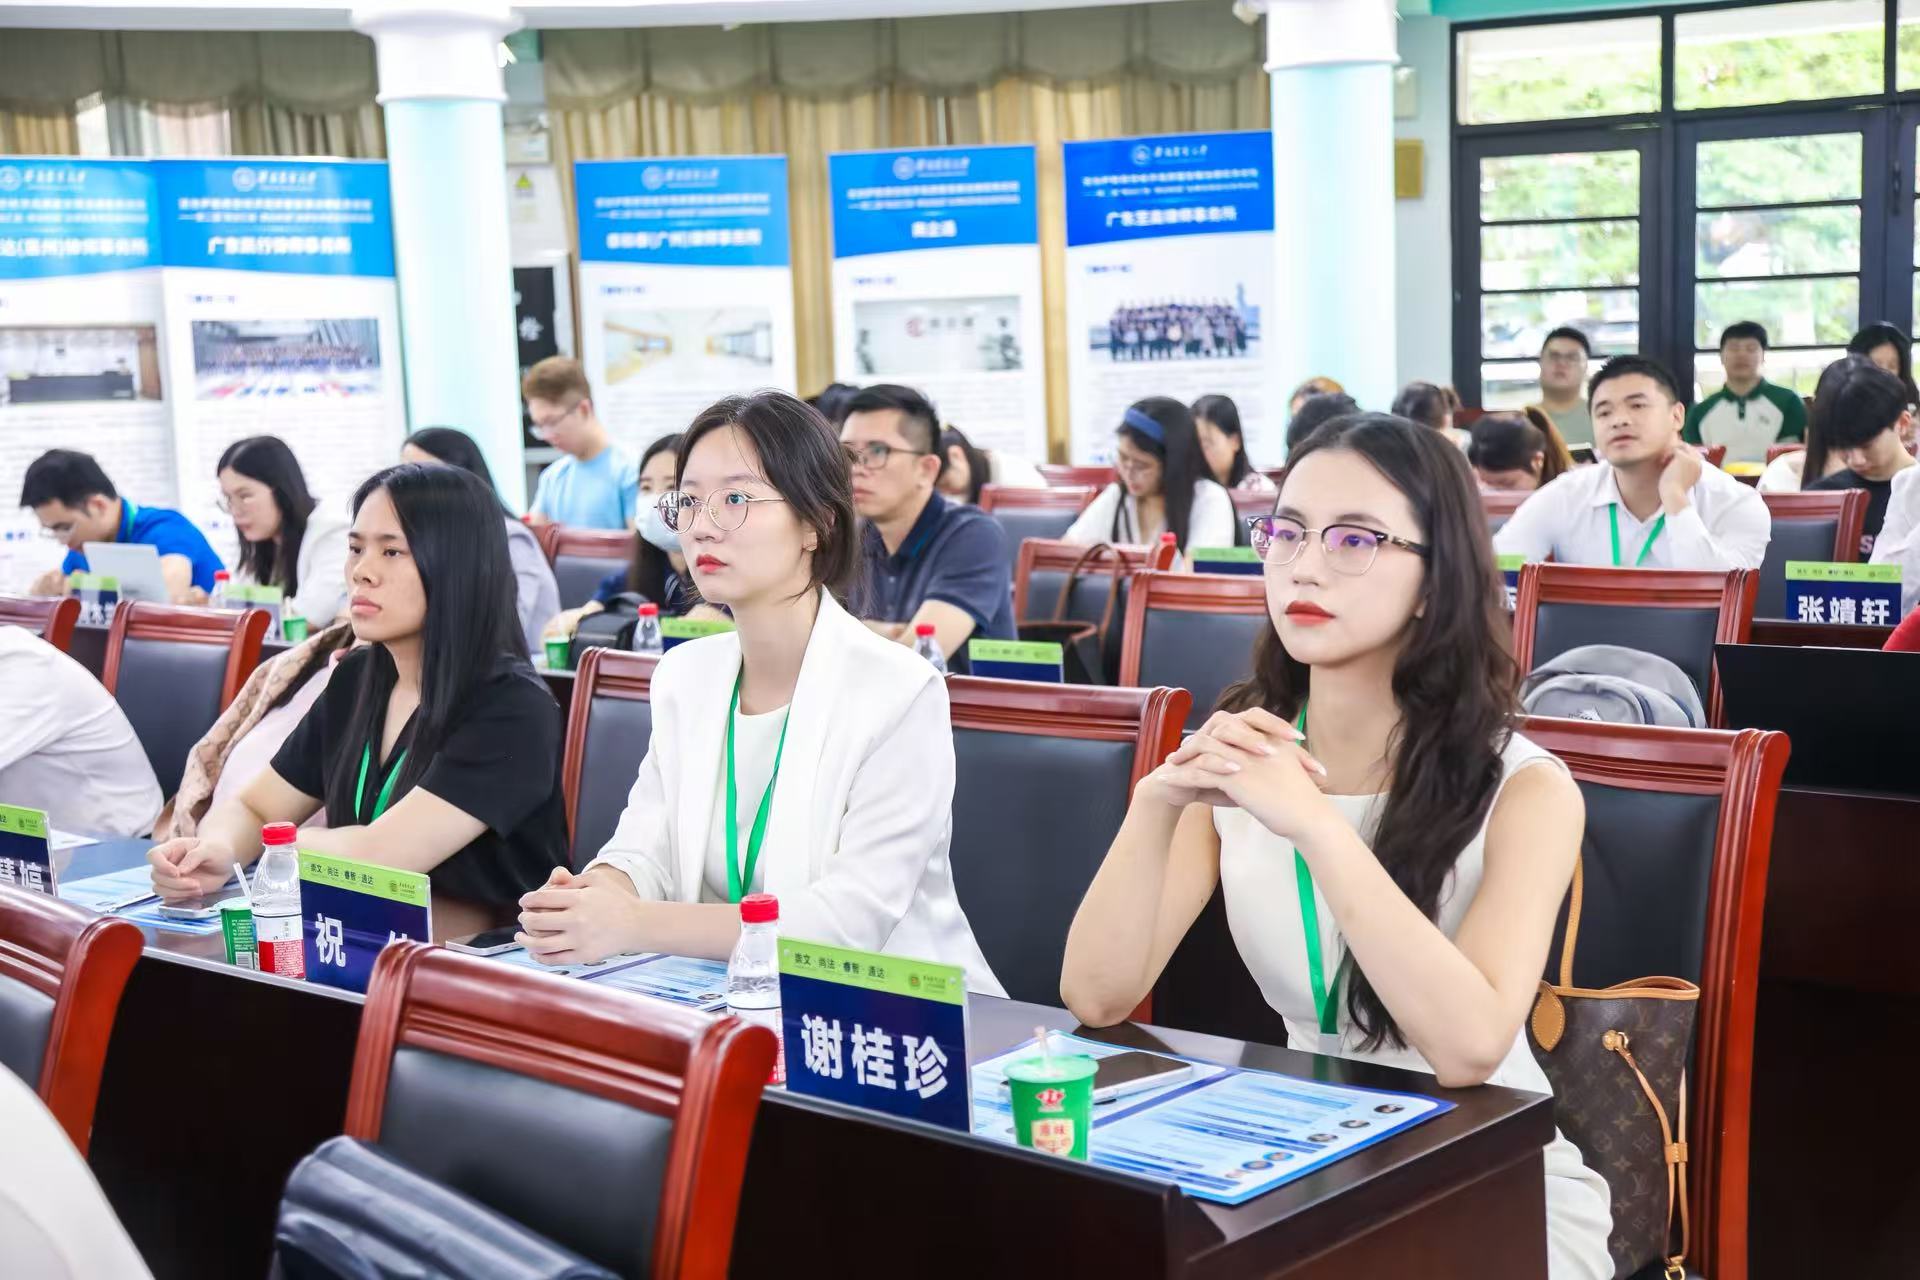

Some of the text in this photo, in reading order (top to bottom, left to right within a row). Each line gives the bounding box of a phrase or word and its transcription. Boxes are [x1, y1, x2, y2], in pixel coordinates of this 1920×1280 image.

[315, 912, 346, 967] 祝
[800, 1013, 949, 1100] 谢桂珍
